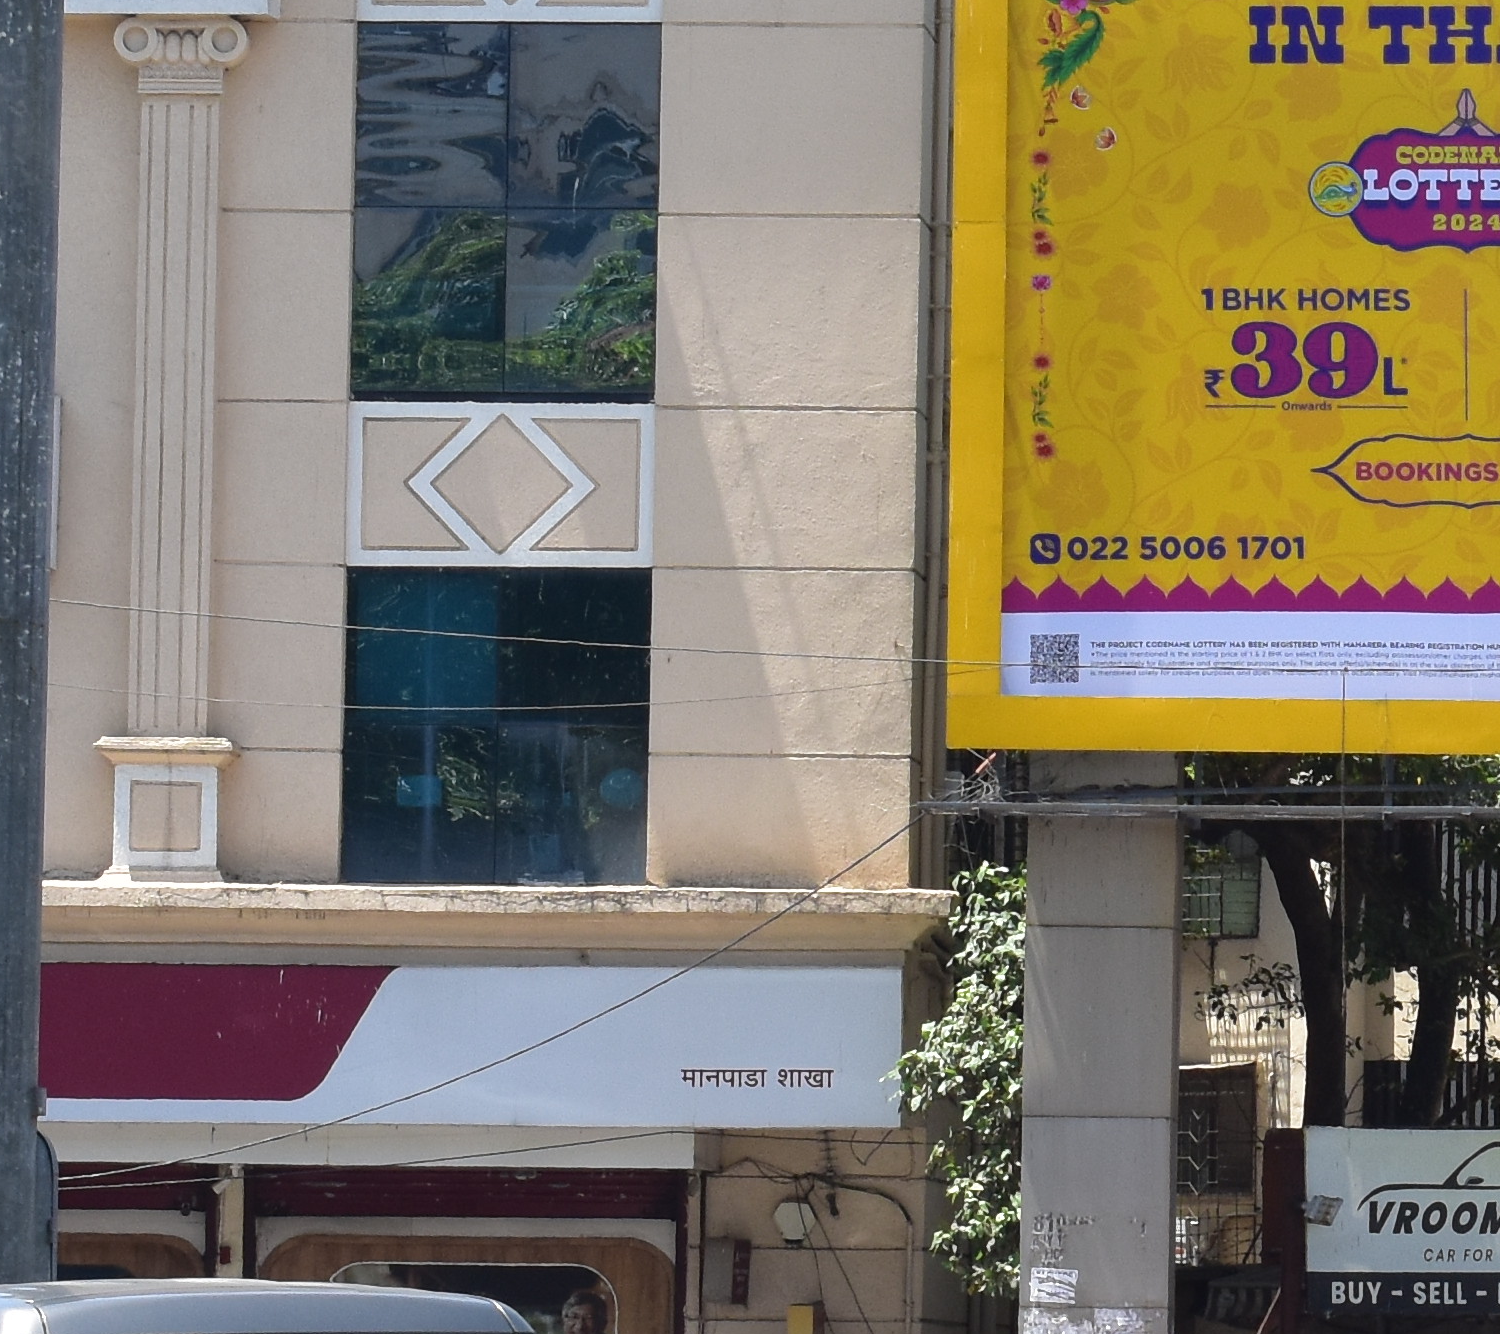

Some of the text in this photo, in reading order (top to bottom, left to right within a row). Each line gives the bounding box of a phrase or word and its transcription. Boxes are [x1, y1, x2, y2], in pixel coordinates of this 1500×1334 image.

[1248, 5, 1345, 65] IN
[1201, 287, 1411, 312] 1 BHK HOMES
[1281, 400, 1333, 412] Onwards
[1355, 460, 1500, 482] BOOKINGS
[1067, 535, 1306, 560] 022 5006 1701
[680, 1068, 835, 1089] मानपाडा शाखा
[1423, 1247, 1456, 1264] CAR
[1463, 1247, 1493, 1264] FOR
[1330, 1280, 1381, 1306] BUY
[1412, 1280, 1468, 1306] SELL
